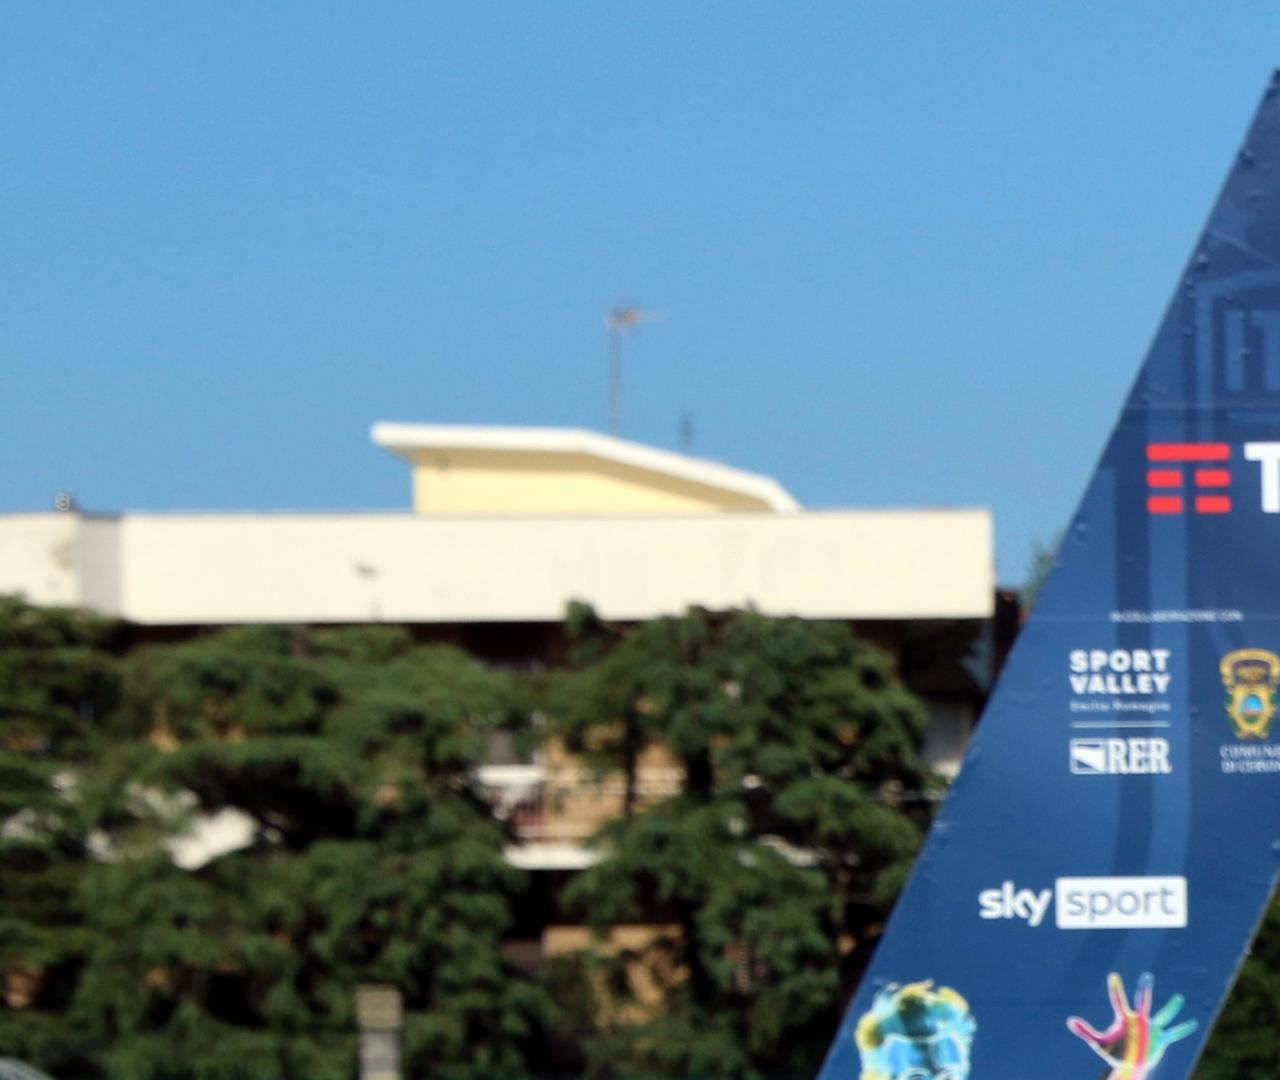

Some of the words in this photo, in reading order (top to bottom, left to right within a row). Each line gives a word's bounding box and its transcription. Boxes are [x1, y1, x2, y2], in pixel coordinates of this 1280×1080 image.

[1070, 649, 1170, 672] SPORT
[1069, 674, 1171, 694] VALLEY
[1108, 738, 1172, 774] RER
[979, 880, 1052, 927] sky
[1066, 887, 1176, 921] sport
